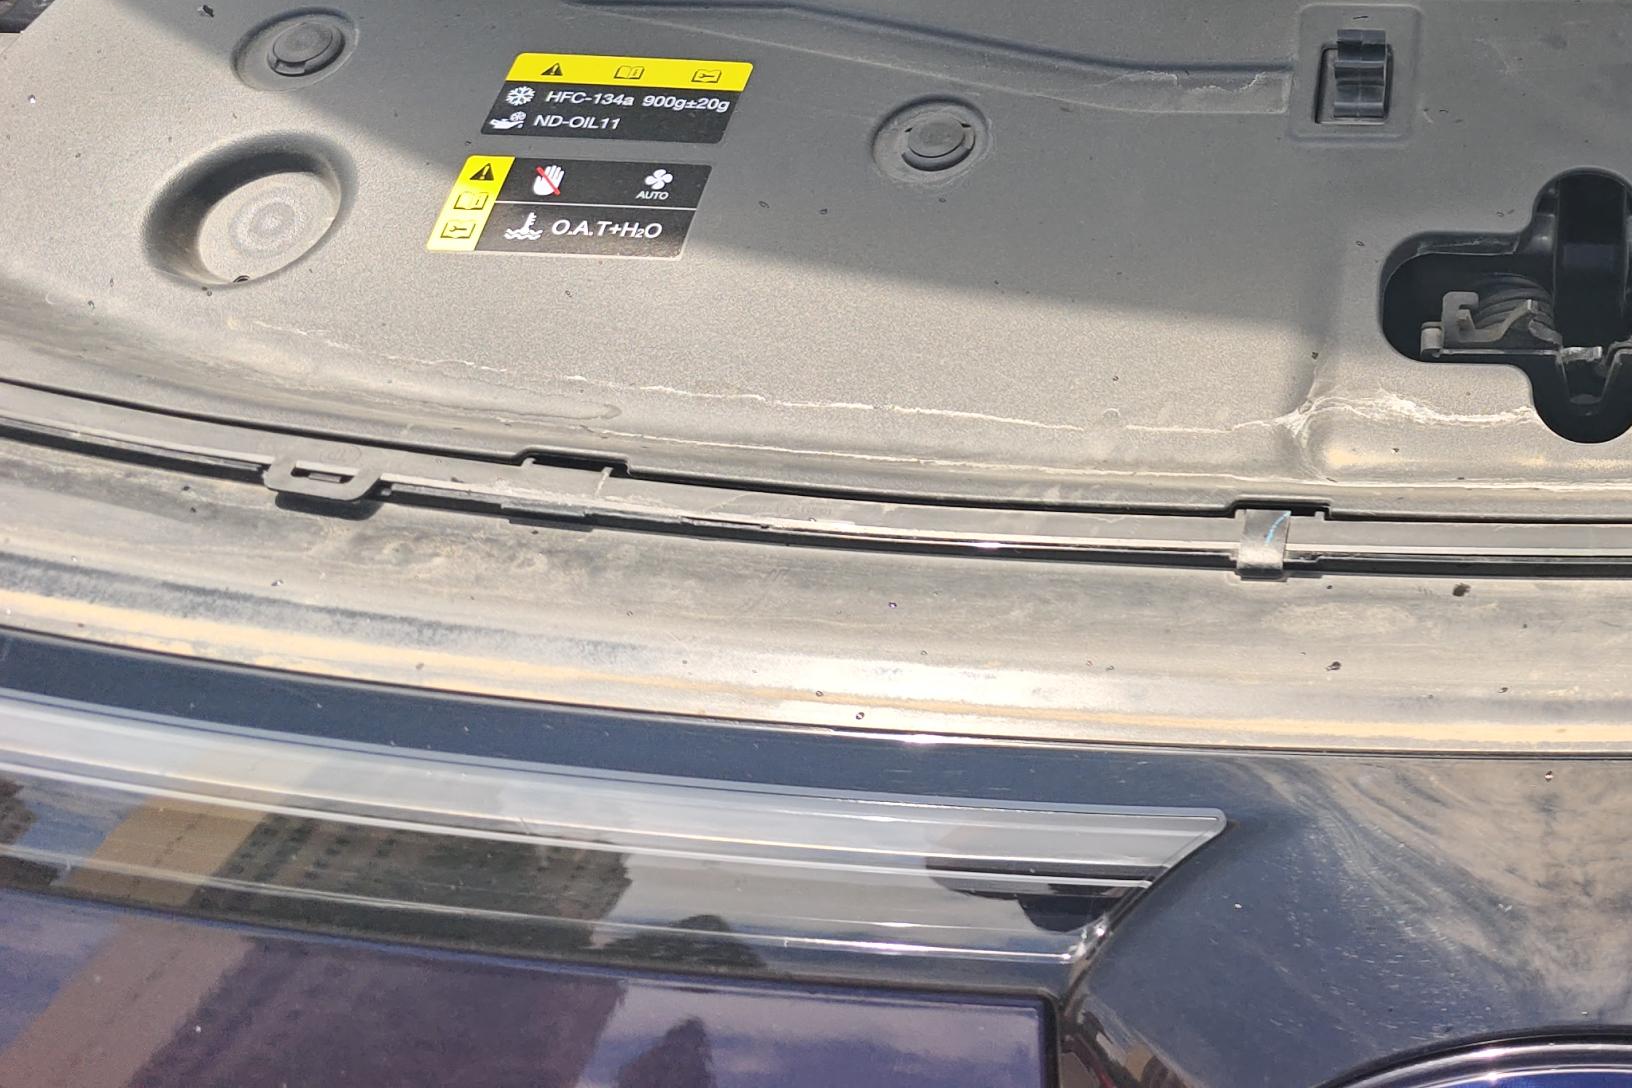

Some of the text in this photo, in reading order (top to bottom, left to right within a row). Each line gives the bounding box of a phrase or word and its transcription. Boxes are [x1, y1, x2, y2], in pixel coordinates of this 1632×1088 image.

[545, 90, 730, 112] HFC-134a 900g±20g
[533, 114, 621, 130] ND-OIL11
[636, 191, 669, 200] AUTO
